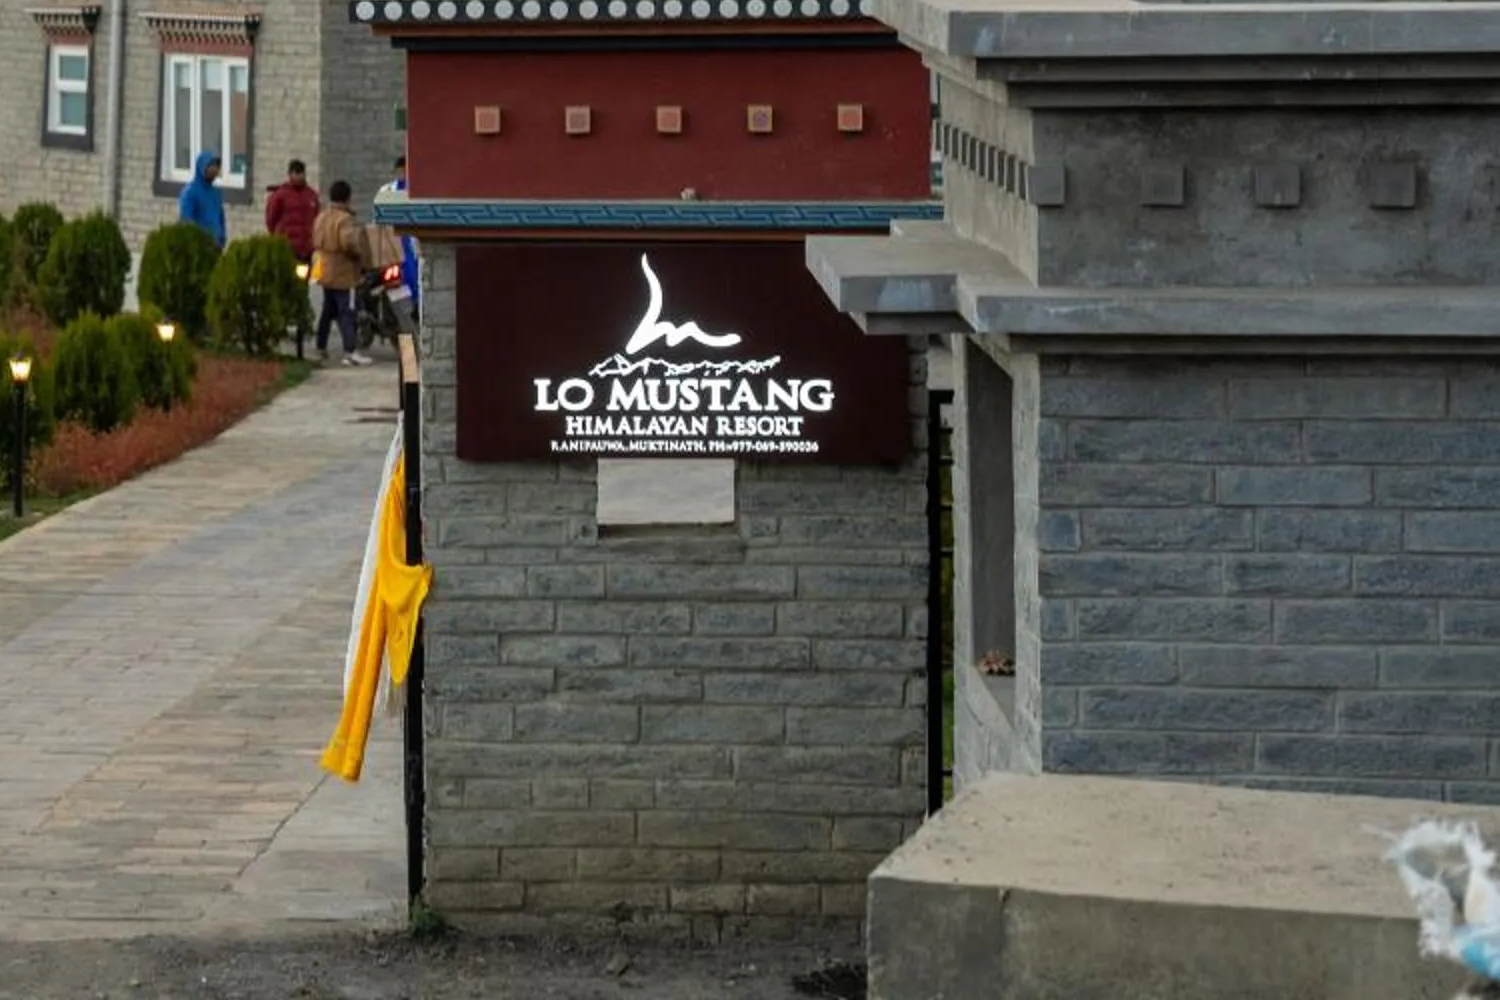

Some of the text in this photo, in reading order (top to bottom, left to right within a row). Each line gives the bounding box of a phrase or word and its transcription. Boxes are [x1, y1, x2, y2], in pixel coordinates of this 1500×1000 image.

[533, 377, 835, 412] LO MUSTANG
[565, 415, 804, 437] HIMALAYAN RESORT
